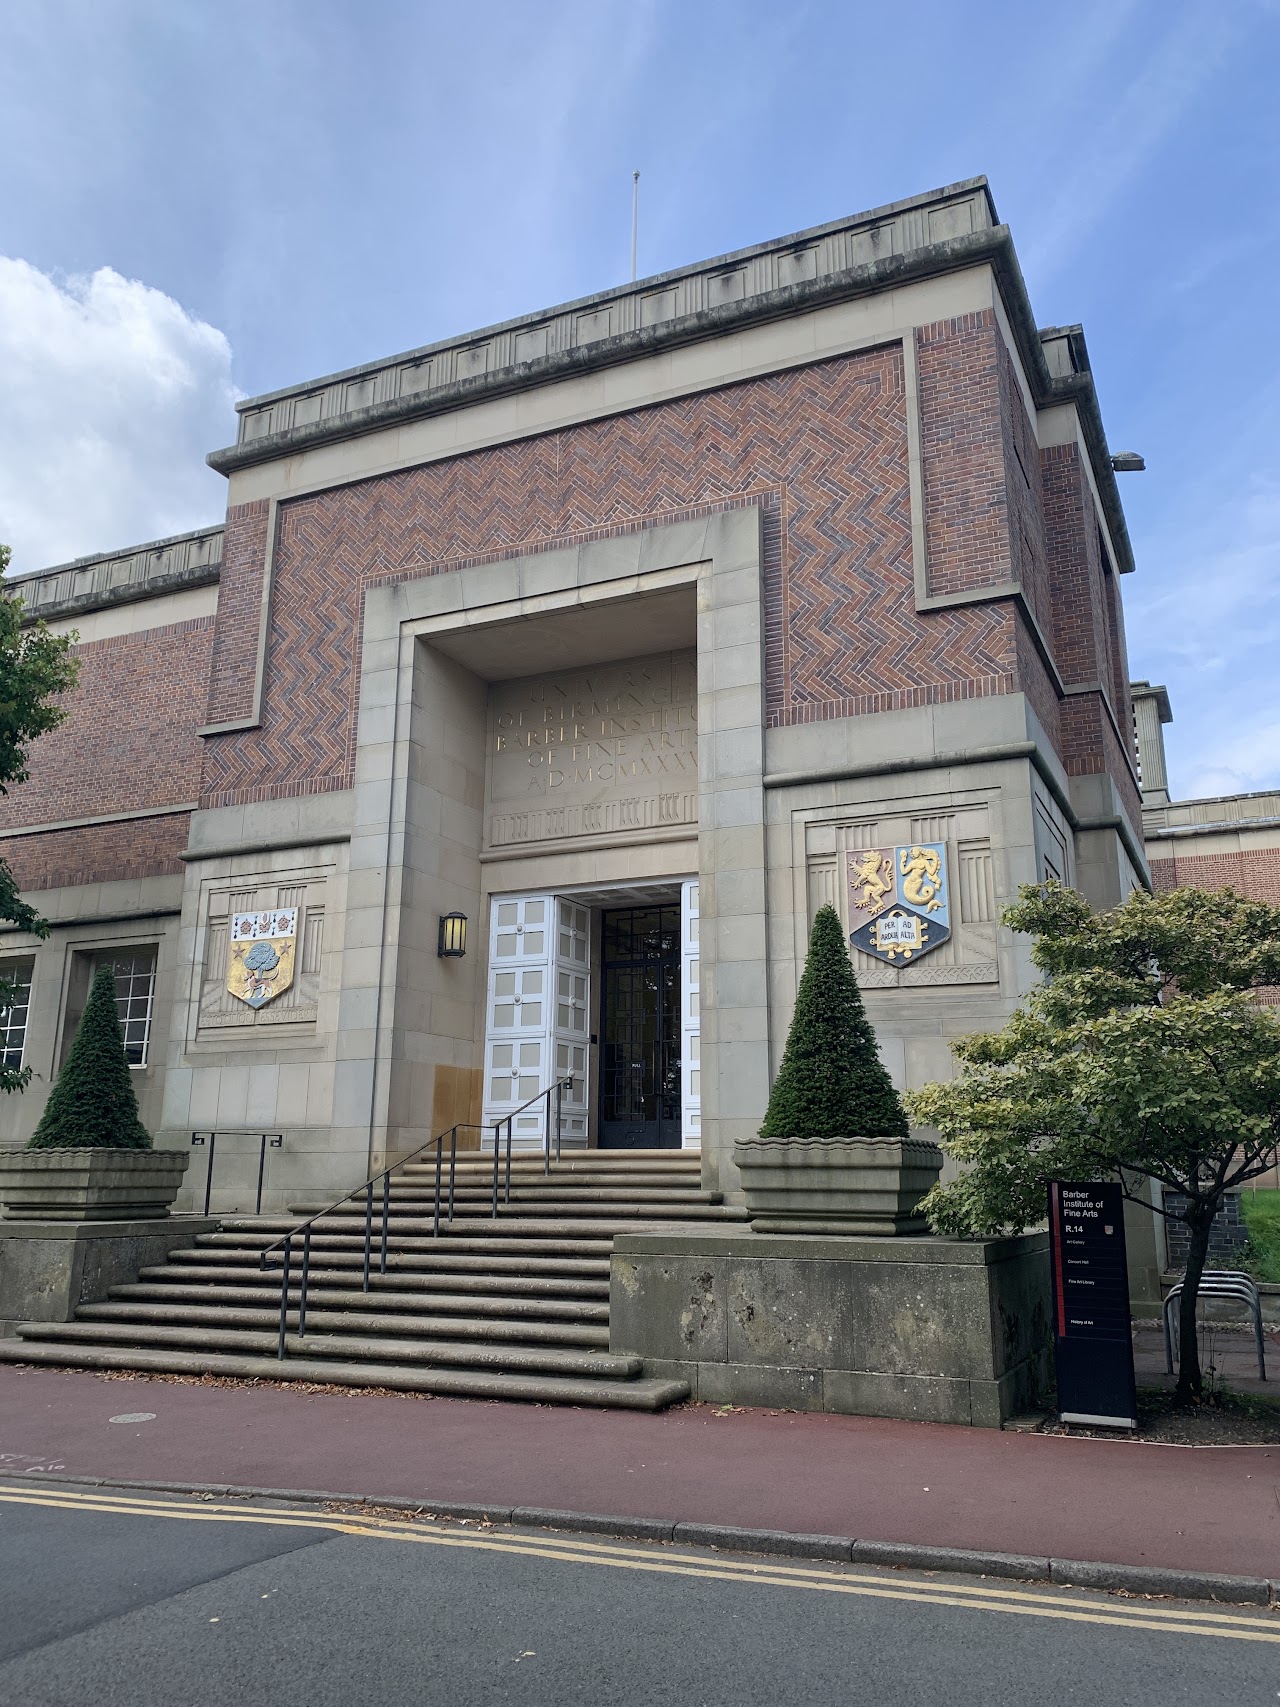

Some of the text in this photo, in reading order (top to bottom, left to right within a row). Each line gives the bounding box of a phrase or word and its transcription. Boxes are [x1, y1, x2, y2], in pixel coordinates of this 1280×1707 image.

[498, 683, 698, 729] OF BIRMINGH
[497, 704, 698, 752] BARBER INSTITU
[527, 748, 558, 769] OF
[572, 738, 628, 762] FINE
[884, 921, 896, 930] PER
[902, 921, 912, 929] AD
[880, 931, 899, 941] ARDUA
[900, 931, 915, 940] ALTA
[1062, 1190, 1089, 1199] Barber
[1063, 1200, 1104, 1209] Institute of
[1063, 1209, 1099, 1218] Fine Arts
[1065, 1225, 1084, 1233] R.14
